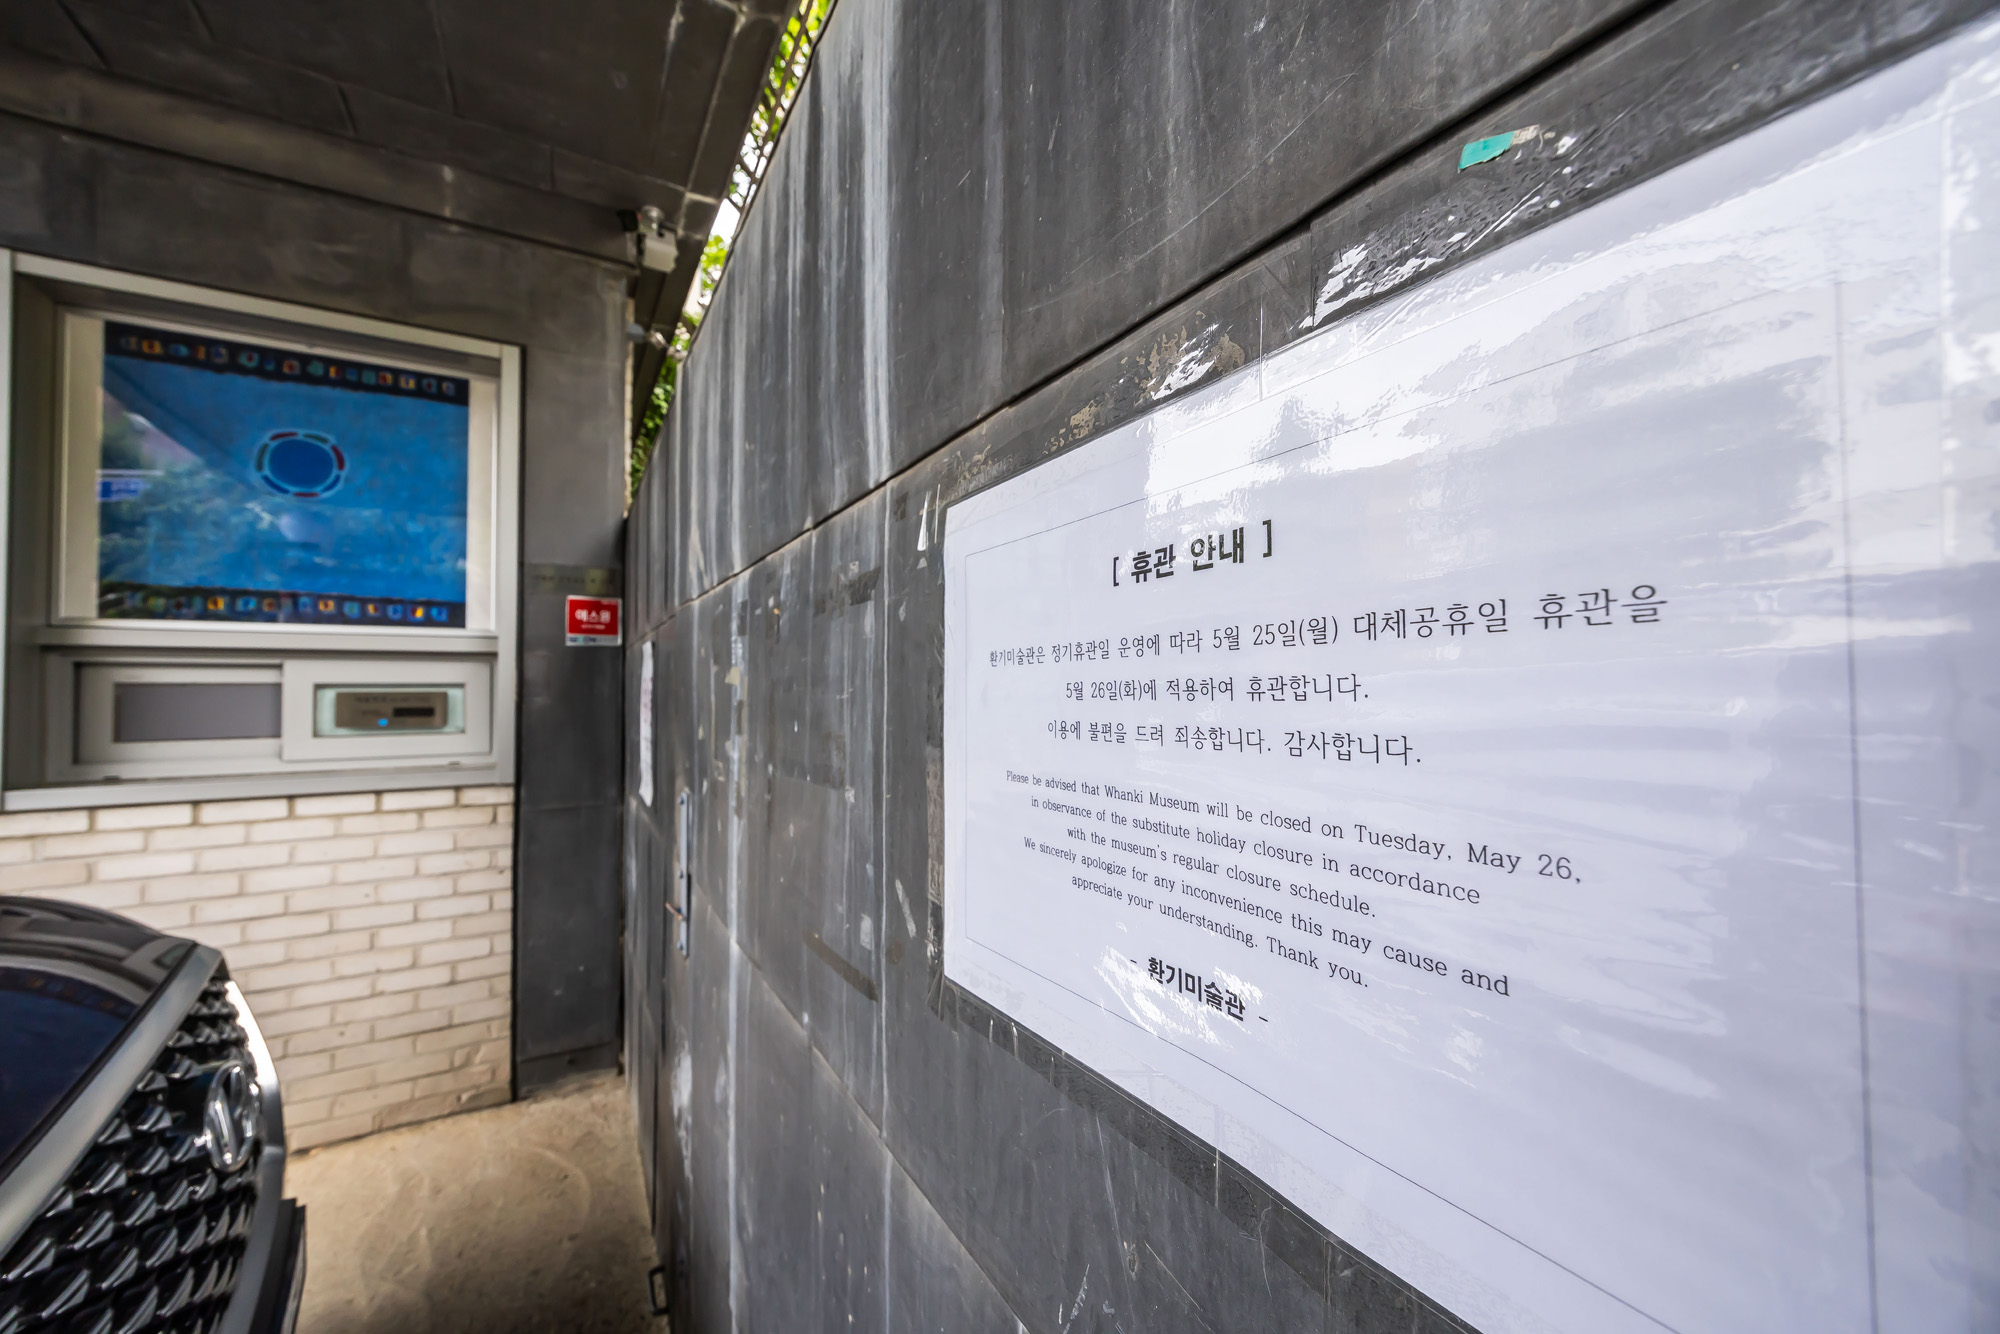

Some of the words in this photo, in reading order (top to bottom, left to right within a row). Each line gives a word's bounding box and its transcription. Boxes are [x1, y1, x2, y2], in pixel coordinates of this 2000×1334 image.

[1131, 544, 1175, 583] 휴관
[1190, 527, 1245, 572] 안내
[989, 645, 1046, 667] 환기미술관은
[1051, 639, 1110, 662] 정기휴관일
[1118, 634, 1160, 658] 운영에
[1170, 630, 1203, 654] 따라
[1213, 626, 1240, 651] 5월
[1253, 615, 1338, 647] 25일(월)
[1353, 599, 1508, 641] 대체공휴일
[1534, 585, 1668, 630] 휴관을
[1066, 681, 1084, 701] 5월
[1091, 679, 1157, 701] 26일(화)에
[1166, 677, 1234, 701] 적용하여
[1246, 673, 1368, 702] 휴관합니다.
[1048, 720, 1081, 741] 이용에
[1088, 722, 1127, 744] 불편을
[1135, 725, 1163, 747] 드려
[1174, 726, 1271, 754] 죄송합니다.
[1284, 731, 1421, 766] 감사합니다.
[1006, 770, 1029, 784] Please
[1032, 774, 1042, 786] be
[1045, 778, 1077, 793] advised
[1081, 781, 1100, 796] that
[1104, 785, 1144, 803] Whanki
[1149, 792, 1200, 814] Museum
[1206, 803, 1229, 818] will
[1236, 805, 1253, 823] be
[1260, 811, 1312, 833] closed
[1321, 821, 1344, 839] on
[1354, 824, 1453, 861] Tuesday,
[1467, 842, 1521, 874] May
[1031, 795, 1039, 807] in
[1042, 798, 1092, 819] observance
[1096, 809, 1106, 822] of
[1111, 812, 1128, 826] the
[1132, 816, 1190, 839] substitute
[1197, 827, 1246, 853] holiday
[1253, 841, 1313, 866] closure
[1322, 854, 1340, 872] in
[1349, 863, 1480, 905] accordance
[1067, 826, 1086, 841] with
[1091, 831, 1106, 846] the
[1173, 852, 1219, 875] regular
[1226, 865, 1281, 891] closure
[1290, 881, 1376, 918] schedule.
[1024, 837, 1036, 849] We
[1039, 842, 1077, 863] sincerely
[1081, 853, 1127, 877] apologize
[1132, 866, 1148, 882] for
[1154, 875, 1175, 892] any
[1181, 882, 1283, 924] inconvenience
[1291, 912, 1323, 937] this
[1332, 927, 1372, 954] may
[1384, 945, 1448, 976] cause
[1461, 968, 1510, 997] and
[1072, 874, 1123, 901] appreciate
[1127, 892, 1153, 910] your
[1159, 903, 1258, 948] understanding.
[1266, 936, 1319, 970] Thank
[1328, 960, 1369, 988] you.
[1148, 956, 1246, 1021] 환기미술관
